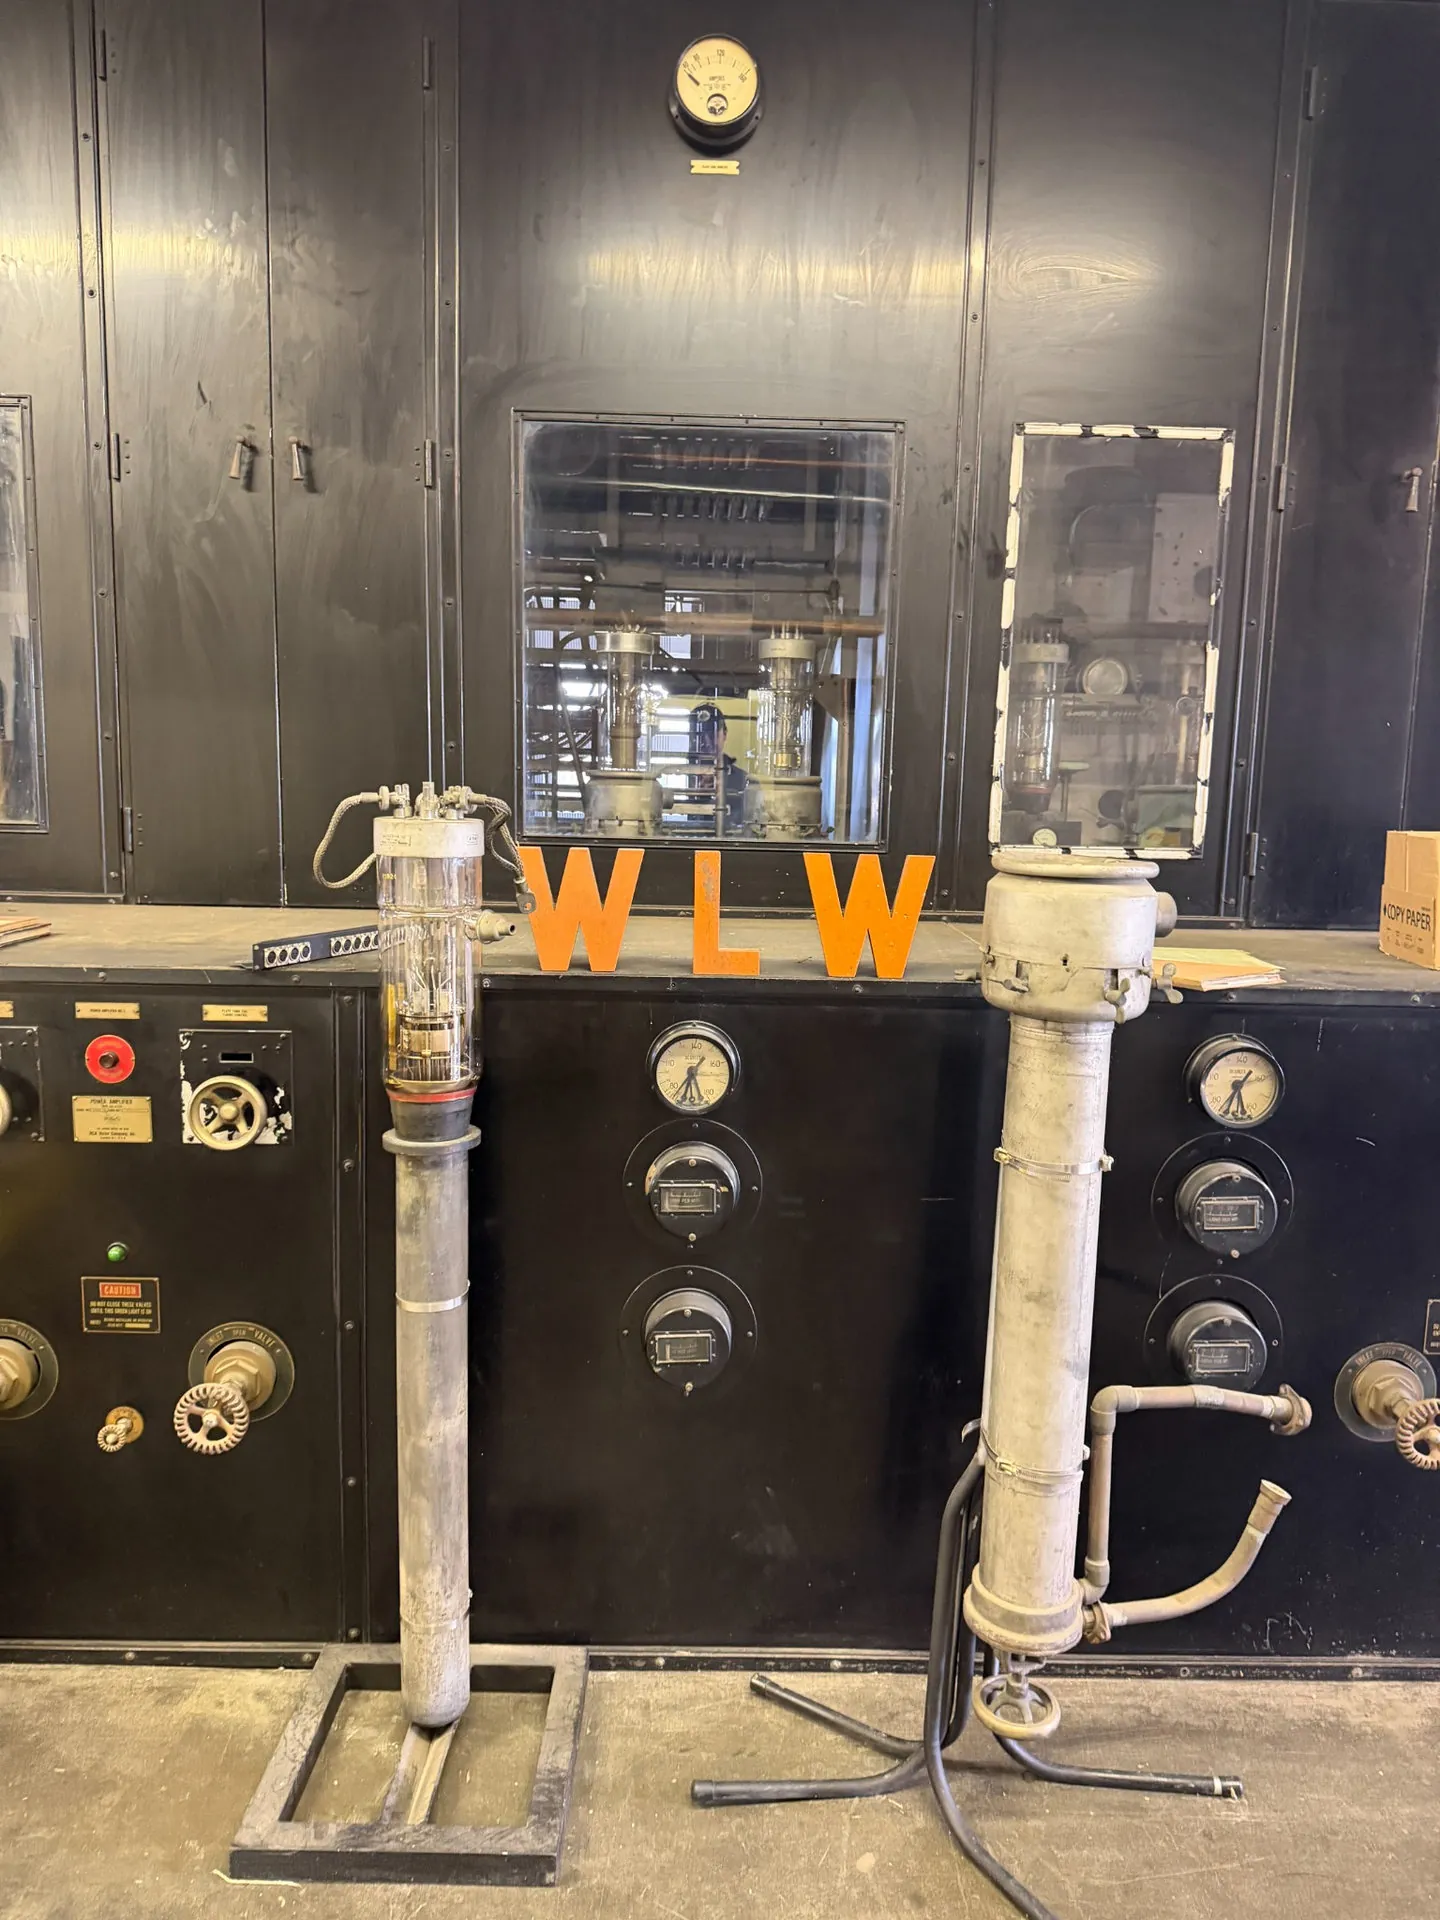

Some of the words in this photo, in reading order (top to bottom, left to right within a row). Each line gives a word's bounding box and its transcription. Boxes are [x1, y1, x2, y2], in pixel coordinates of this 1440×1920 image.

[1387, 903, 1406, 923] COPY
[1406, 908, 1431, 932] PAPER
[691, 1042, 702, 1050] 140
[104, 1285, 137, 1295] CAUTION
[254, 1329, 276, 1347] VALVE
[1355, 1349, 1374, 1365] INLET
[1403, 1350, 1422, 1368] VALVE
